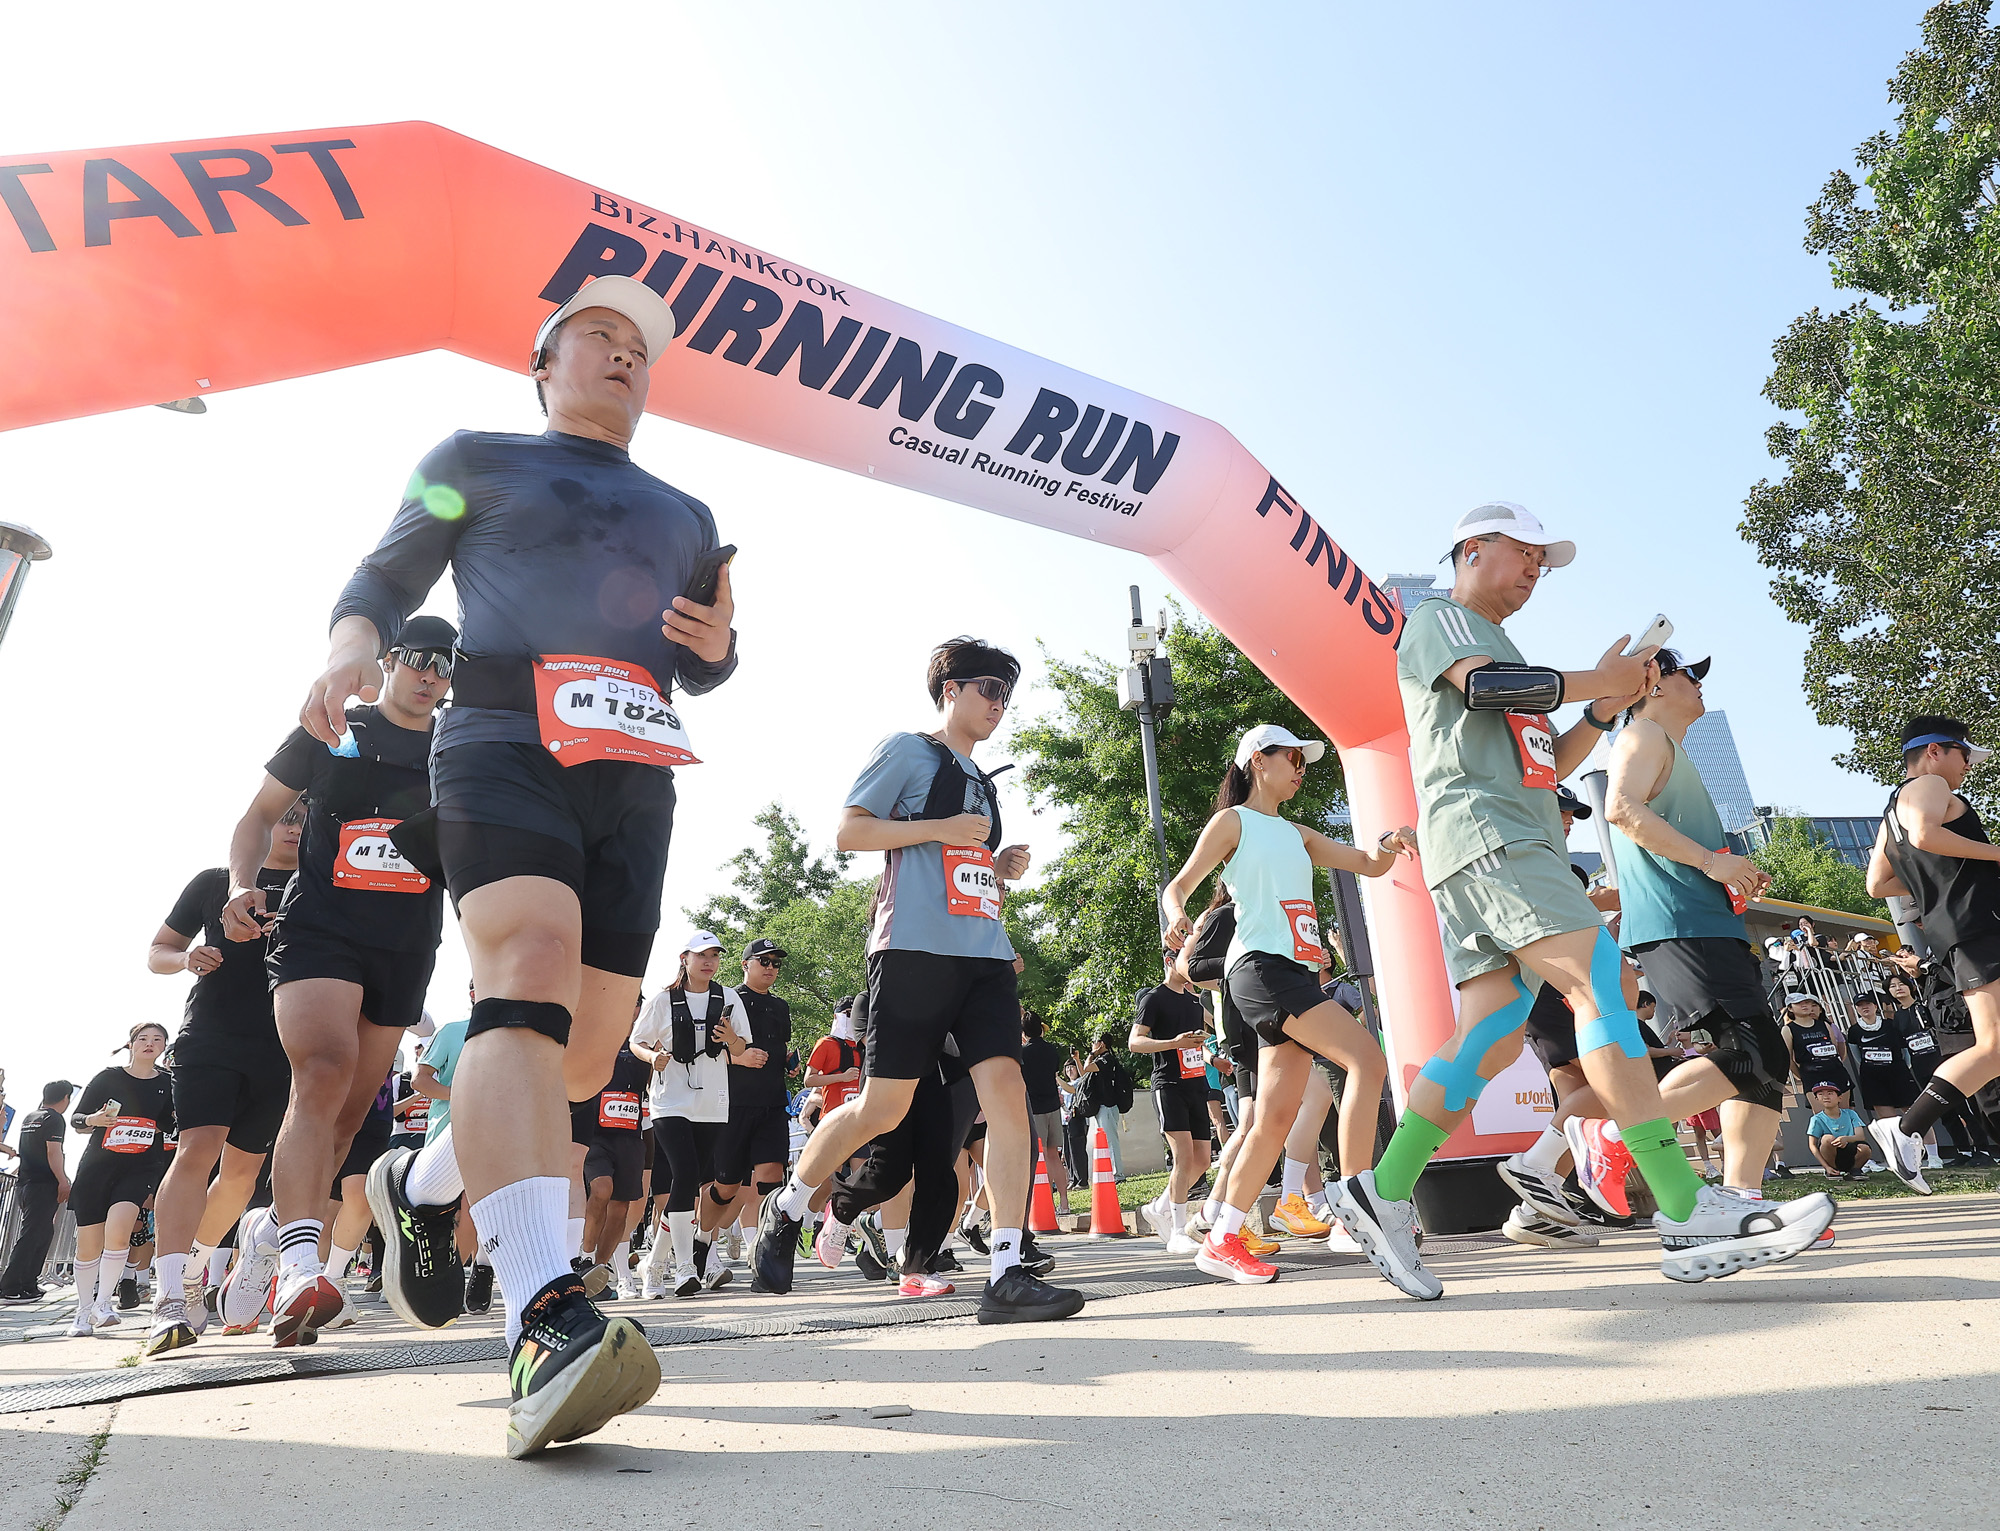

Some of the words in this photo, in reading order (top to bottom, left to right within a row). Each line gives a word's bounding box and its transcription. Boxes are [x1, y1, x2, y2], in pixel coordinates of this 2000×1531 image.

[0, 139, 365, 253] TART
[538, 222, 1004, 440] BURNING
[1004, 387, 1180, 495] RUN
[888, 426, 970, 466] Casual
[971, 452, 1062, 497] Running
[1064, 480, 1143, 518] Festival
[543, 661, 602, 673] BURNING
[604, 665, 630, 677] RUN
[608, 682, 655, 703] D-157
[571, 692, 593, 708] M
[605, 698, 681, 731] 1829
[574, 737, 589, 746] Drop
[1529, 737, 1540, 749] M
[1540, 736, 1555, 755] 22
[345, 823, 379, 831] BURNING
[355, 846, 371, 856] M
[377, 844, 401, 859] 15
[961, 872, 971, 883] M
[974, 871, 997, 889] 150
[1301, 922, 1308, 932] W
[617, 1104, 638, 1113] 1486
[125, 1129, 153, 1139] 4585
